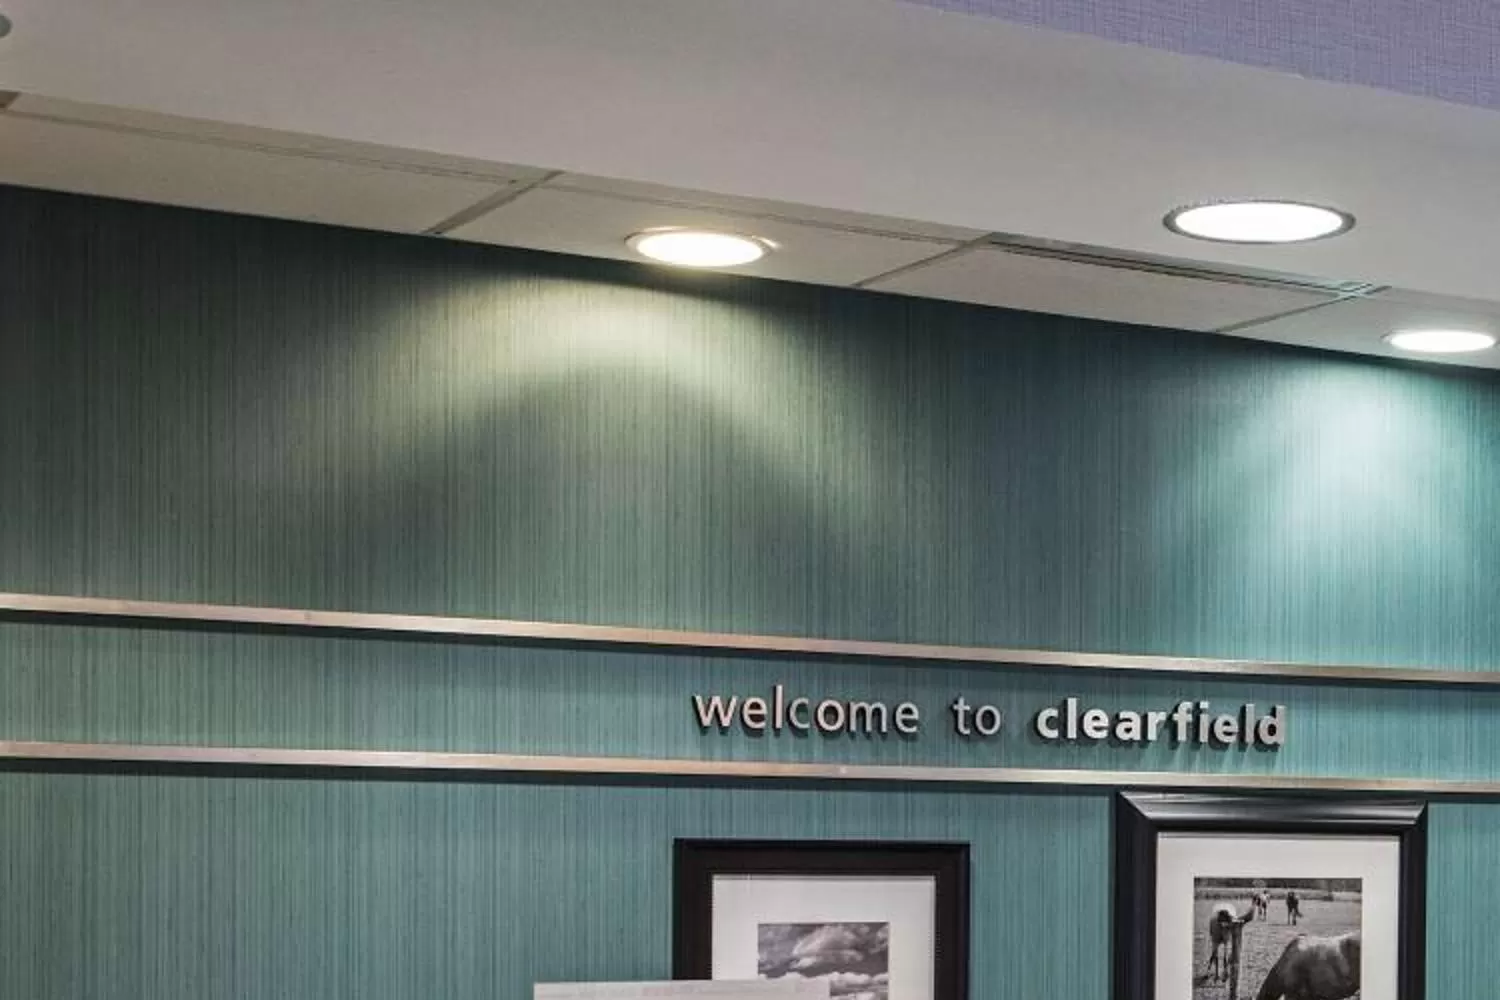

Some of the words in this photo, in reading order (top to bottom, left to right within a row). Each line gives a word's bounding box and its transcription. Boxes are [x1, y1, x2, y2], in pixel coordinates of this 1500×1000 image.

[695, 685, 919, 733] welcome
[953, 697, 1002, 736] to
[1036, 698, 1286, 746] clearfield
